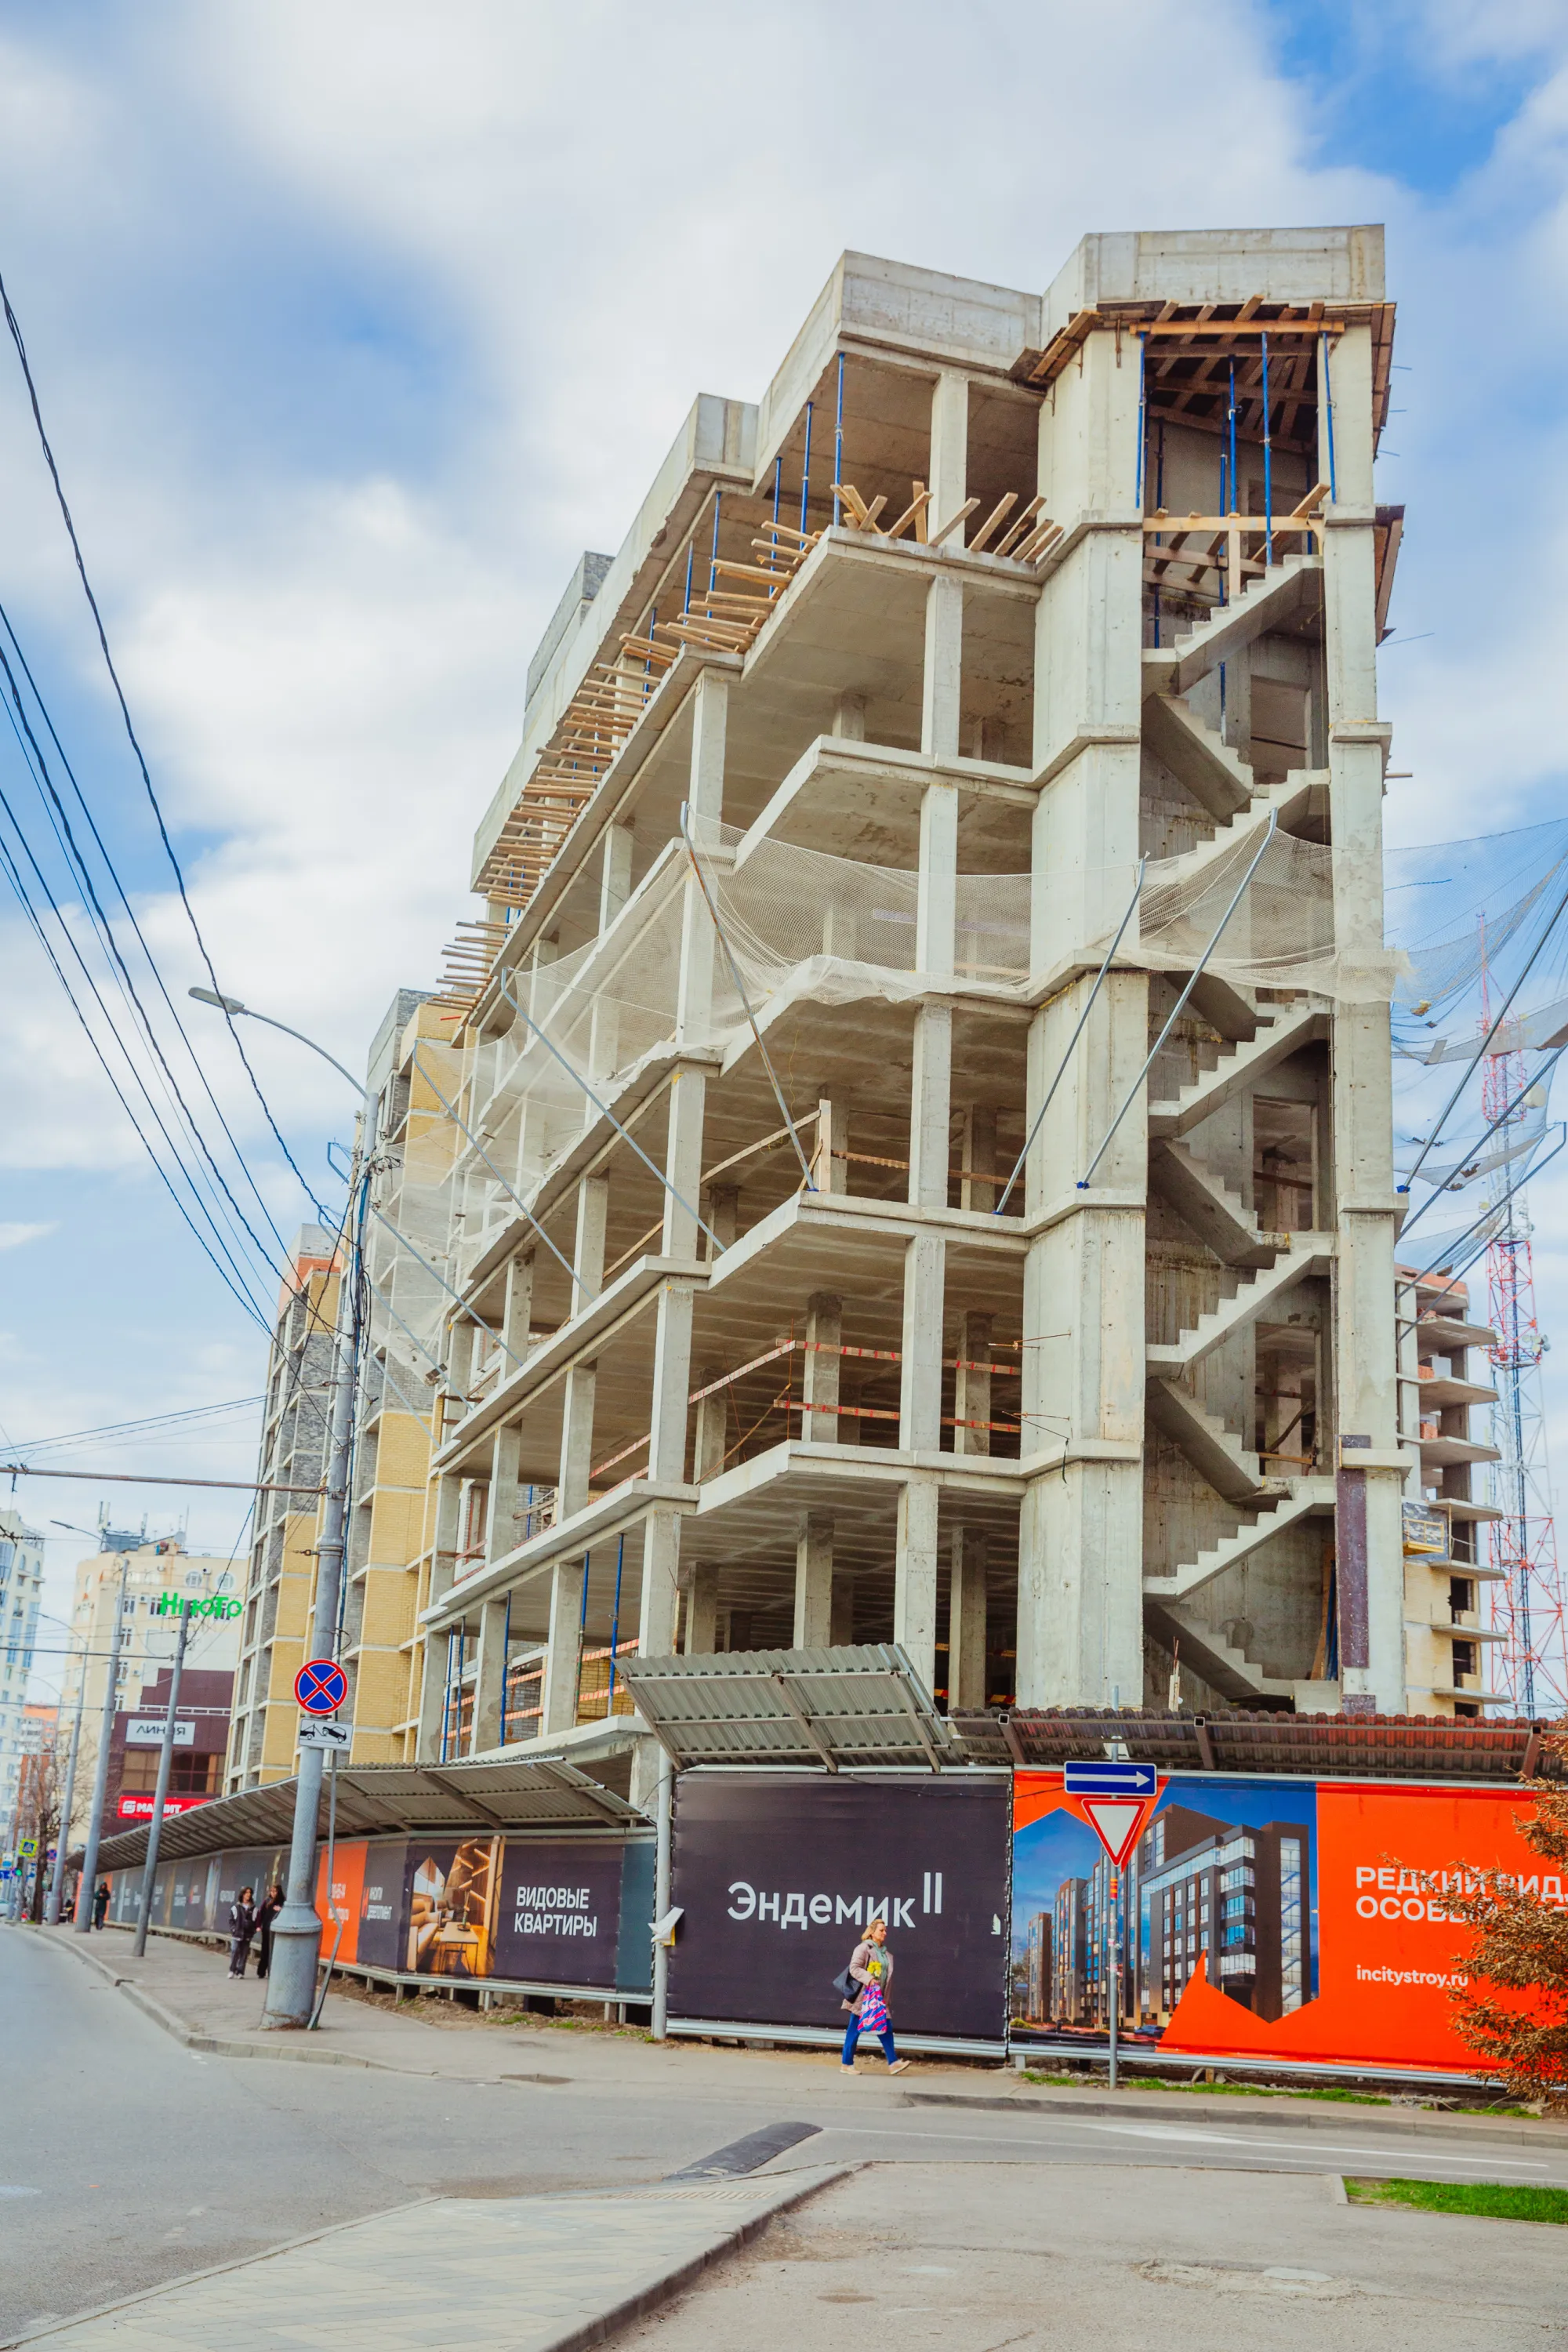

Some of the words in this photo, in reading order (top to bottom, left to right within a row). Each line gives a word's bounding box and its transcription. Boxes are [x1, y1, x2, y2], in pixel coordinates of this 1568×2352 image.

[136, 1725, 187, 1736] ЛИНЯ
[136, 1802, 183, 1814] МАИТ
[1356, 1866, 1486, 1896] РЕДКИЙ
[516, 1886, 590, 1911] ВИДОВЫЕ
[727, 1882, 916, 1930] Эндемик
[514, 1912, 597, 1937] КВАРТИРЫ
[1356, 1964, 1468, 1989] incitystroy.ru
